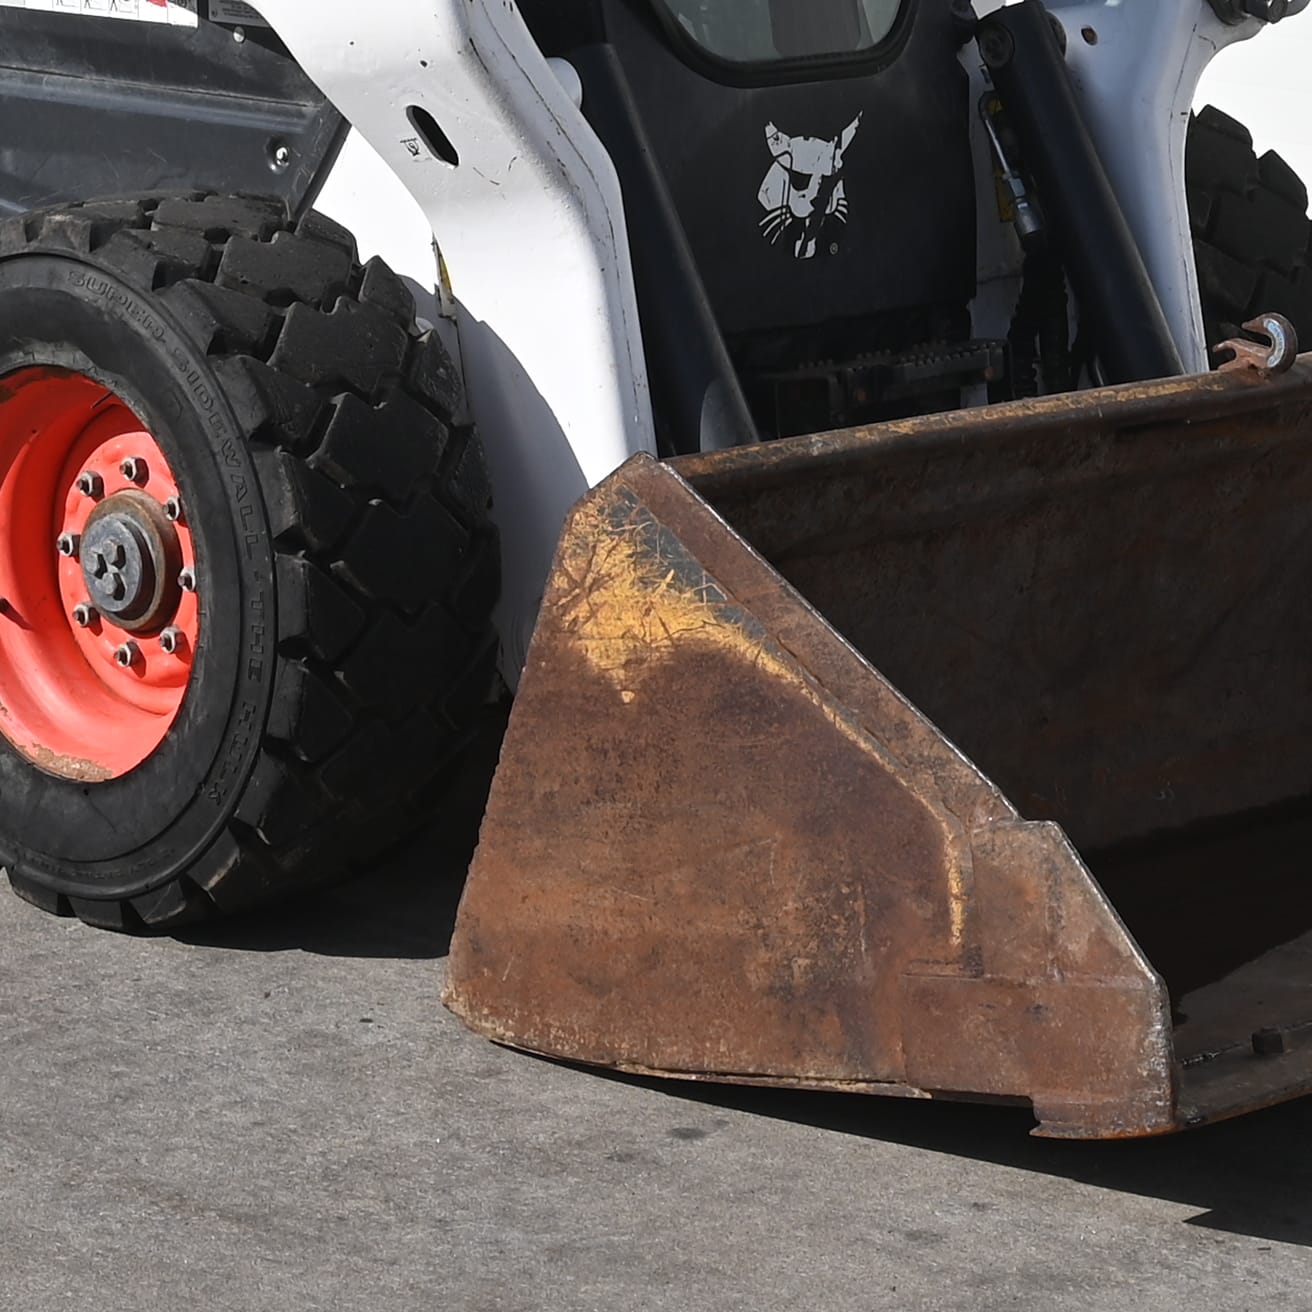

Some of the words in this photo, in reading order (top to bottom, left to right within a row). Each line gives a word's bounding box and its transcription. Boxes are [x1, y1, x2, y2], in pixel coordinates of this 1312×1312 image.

[172, 346, 262, 562] SIDEWALL
[247, 591, 267, 683] THE
[205, 699, 258, 808] HULK
